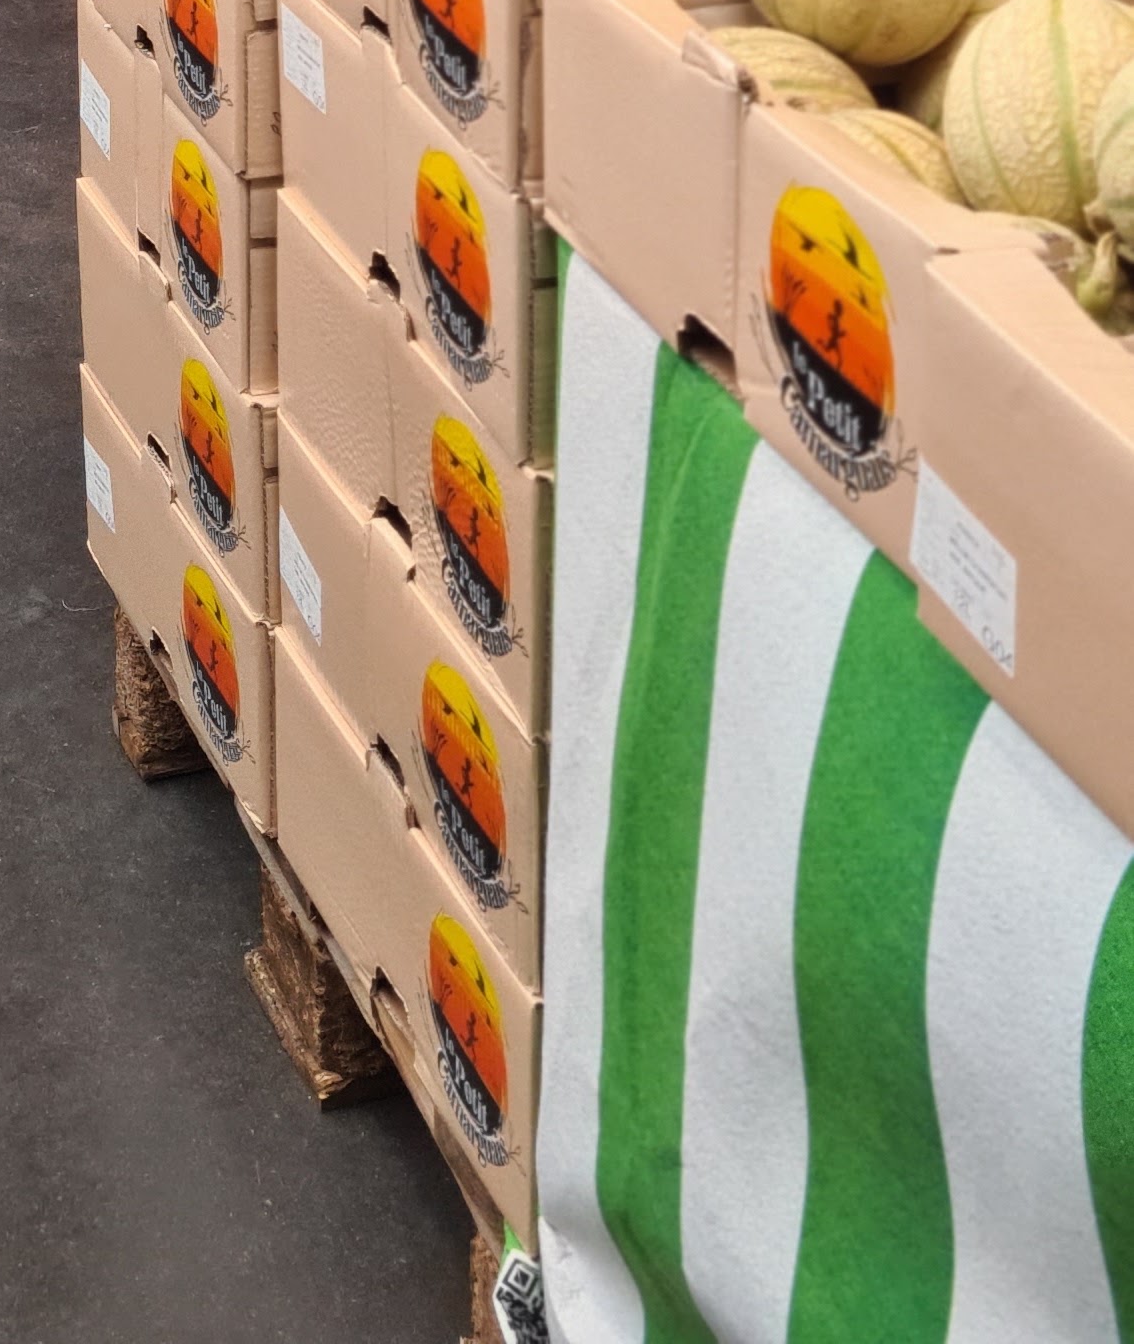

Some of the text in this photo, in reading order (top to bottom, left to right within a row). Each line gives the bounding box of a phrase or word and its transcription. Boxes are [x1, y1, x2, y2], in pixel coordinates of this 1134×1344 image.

[808, 370, 861, 451] Petit
[199, 474, 223, 525] Petit
[458, 557, 492, 624] Petit
[454, 1055, 488, 1131] Petit
